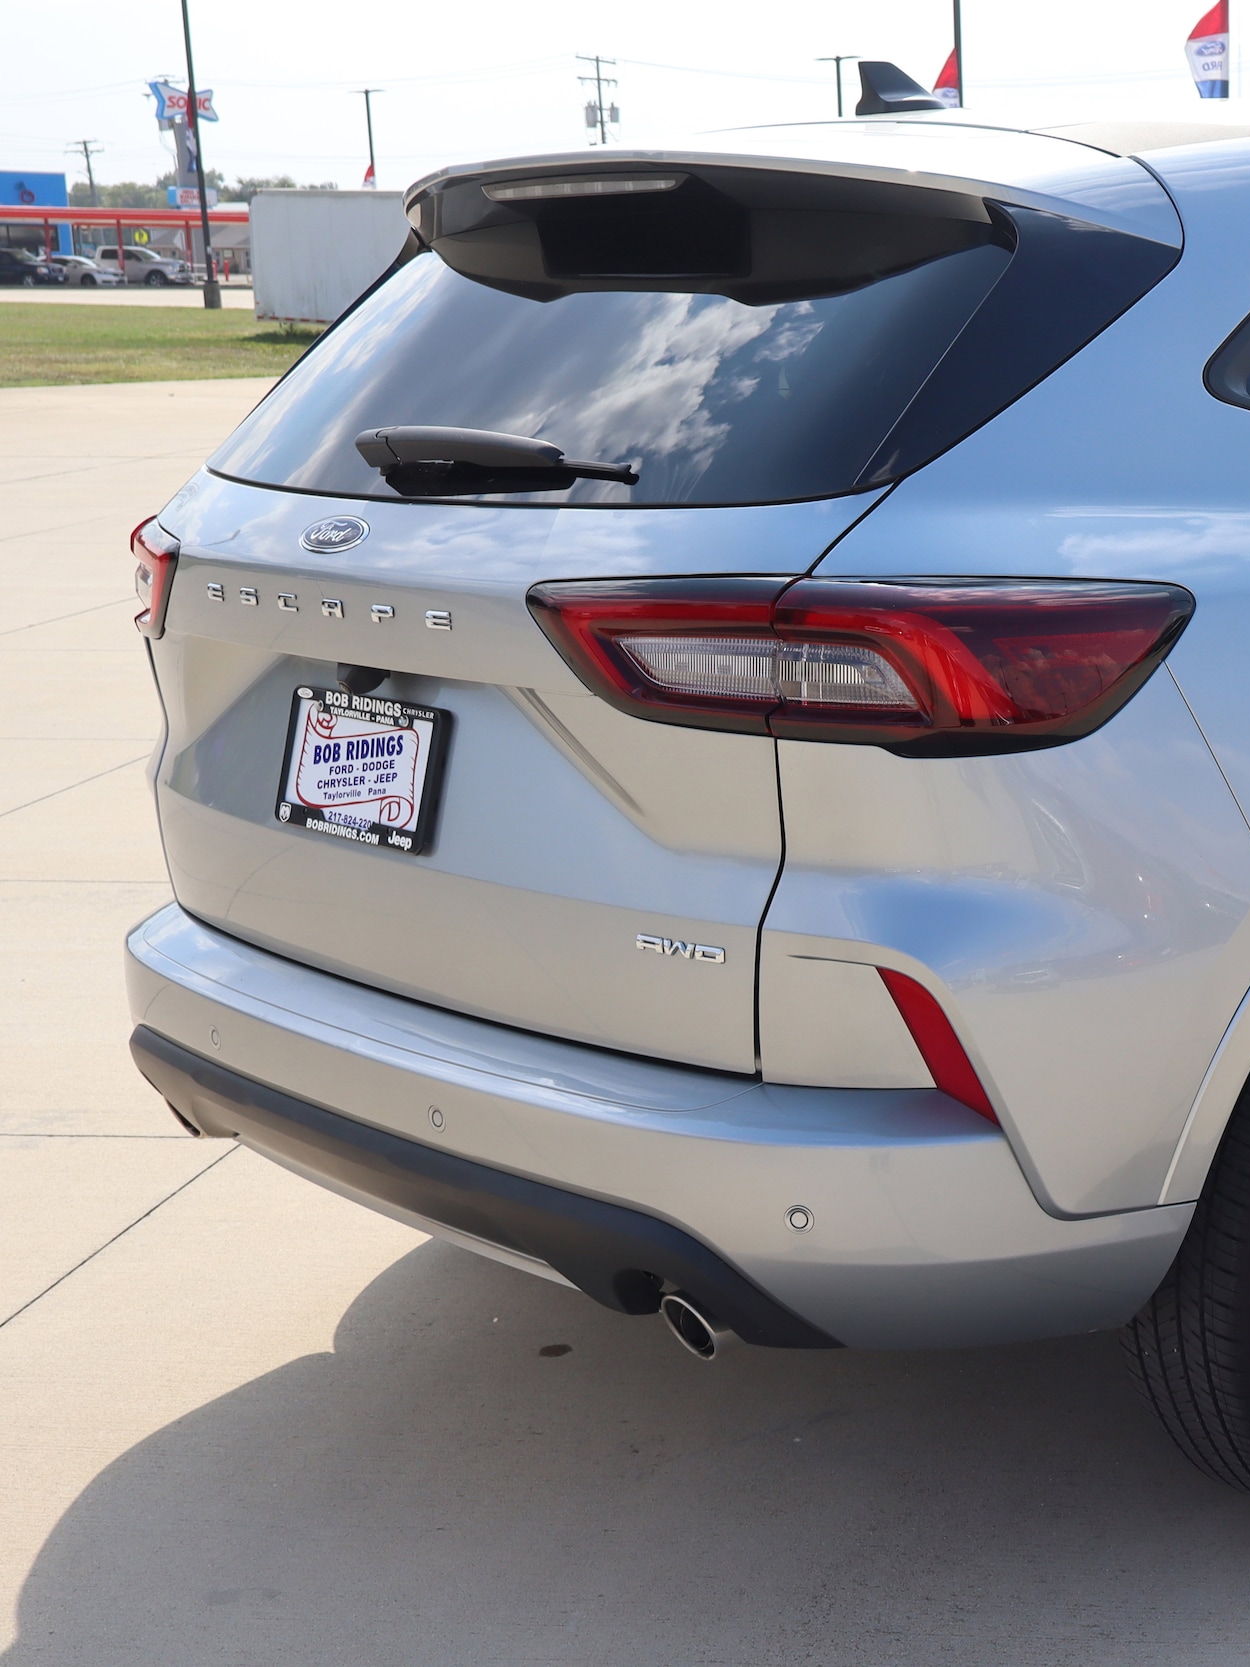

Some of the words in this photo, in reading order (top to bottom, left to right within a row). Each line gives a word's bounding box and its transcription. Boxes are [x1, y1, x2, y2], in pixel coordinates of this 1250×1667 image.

[167, 96, 211, 111] SOIC
[206, 582, 453, 631] ESCAPE
[325, 690, 349, 708] BOB
[352, 695, 402, 717] RIDINGS
[402, 708, 434, 719] CHRYSLER
[330, 706, 370, 721] TAYLORVILLE
[376, 715, 394, 726] PANA
[313, 742, 341, 765] BOB
[346, 734, 404, 761] RIDINGS
[329, 764, 354, 776] FORD
[362, 760, 395, 772] DODGE
[317, 776, 365, 790] CHRYSLER
[373, 772, 398, 784] JEEP
[323, 789, 362, 801] Taylorville
[368, 787, 387, 796] Pana
[328, 810, 376, 830] 217-824-220
[306, 818, 380, 846] BOBRIDINGS.COM
[387, 831, 412, 851] Jeep
[635, 933, 726, 964] AWD
